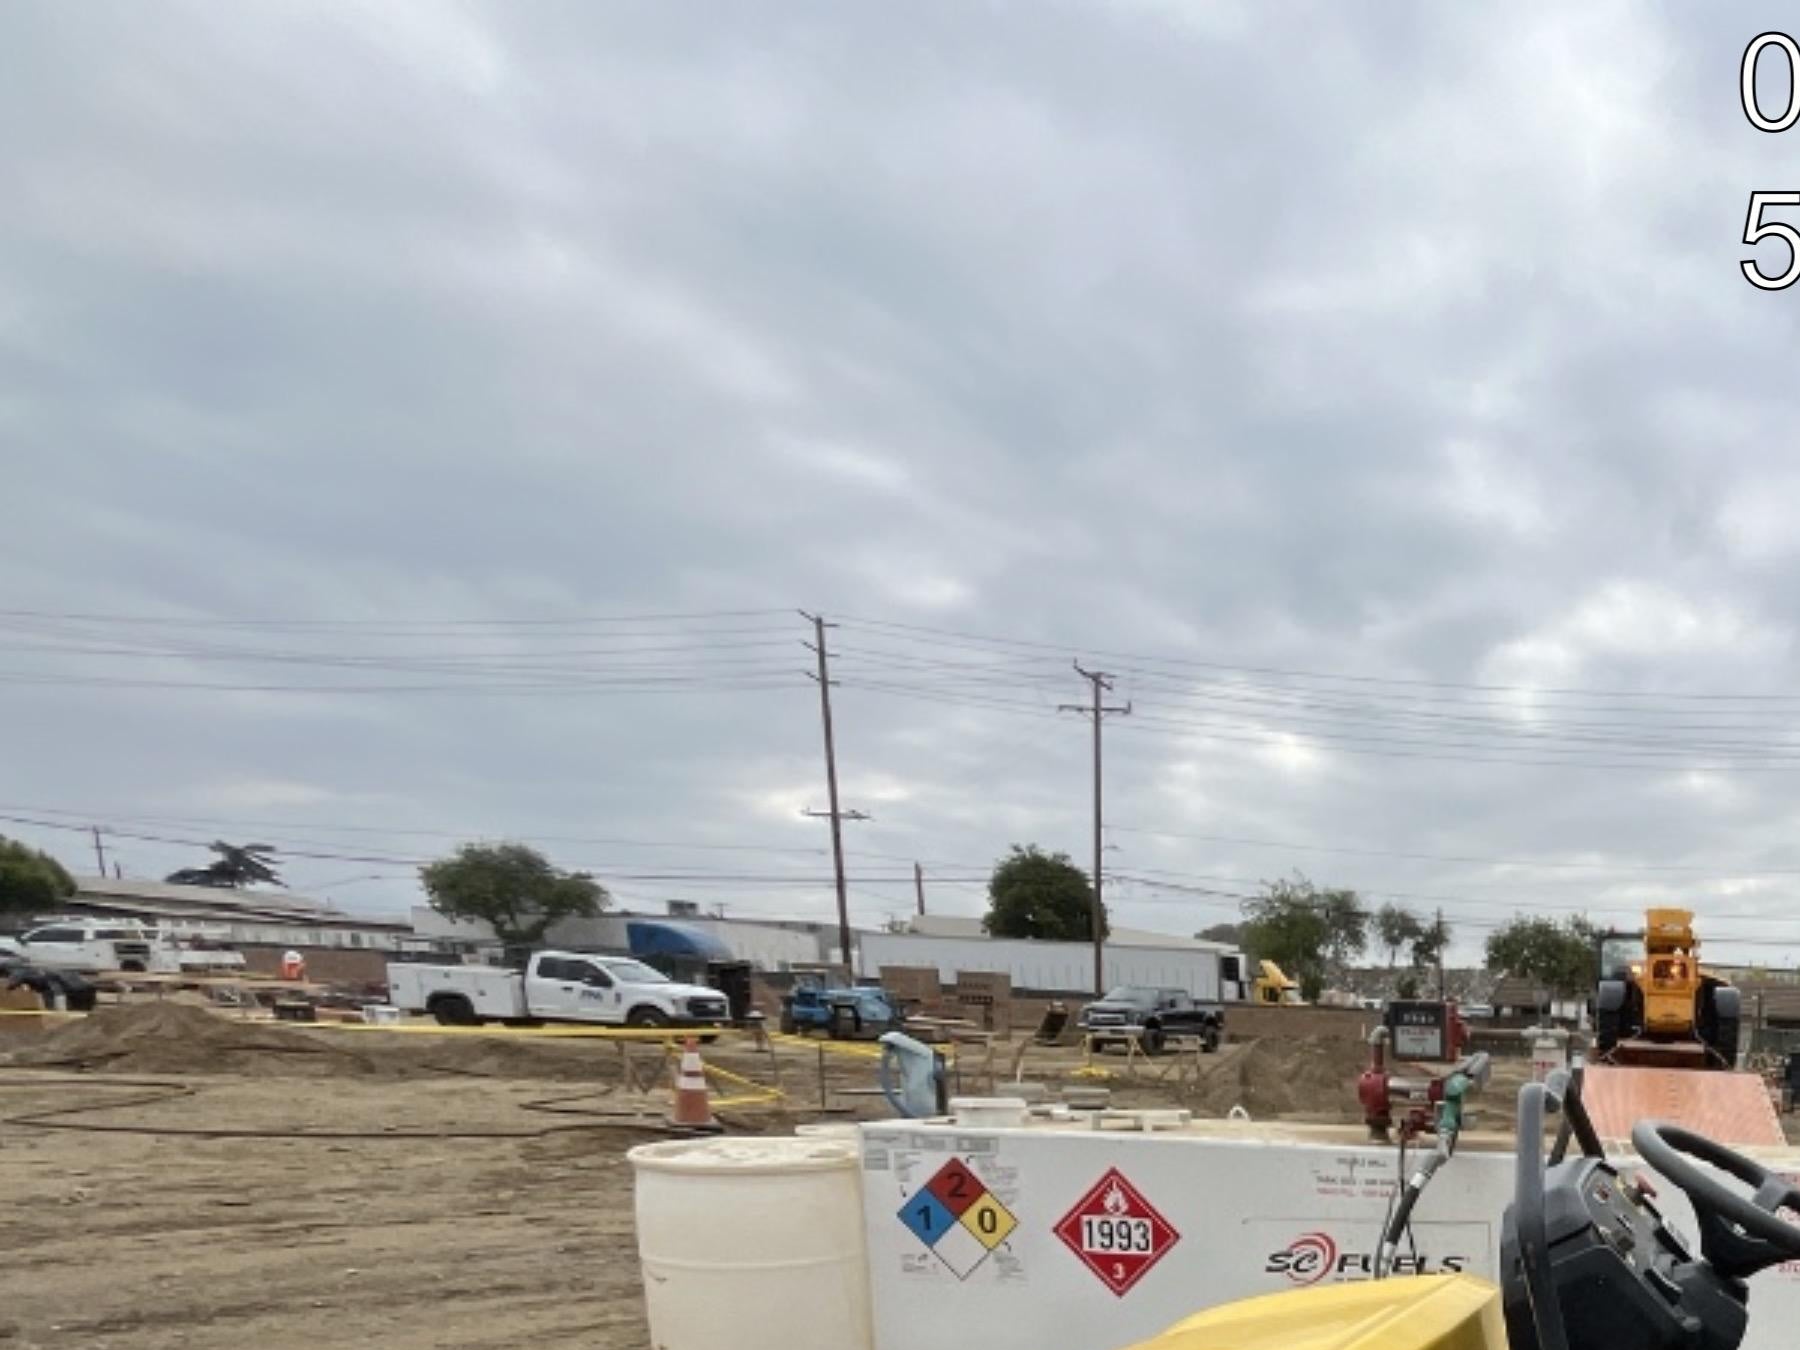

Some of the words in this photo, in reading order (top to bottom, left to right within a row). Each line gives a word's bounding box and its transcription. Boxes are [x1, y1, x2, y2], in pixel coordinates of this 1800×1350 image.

[947, 1172, 968, 1198] 2
[916, 1205, 933, 1231] 1
[977, 1207, 998, 1234] 0
[1085, 1219, 1150, 1251] 1993
[1112, 1262, 1126, 1279] 3
